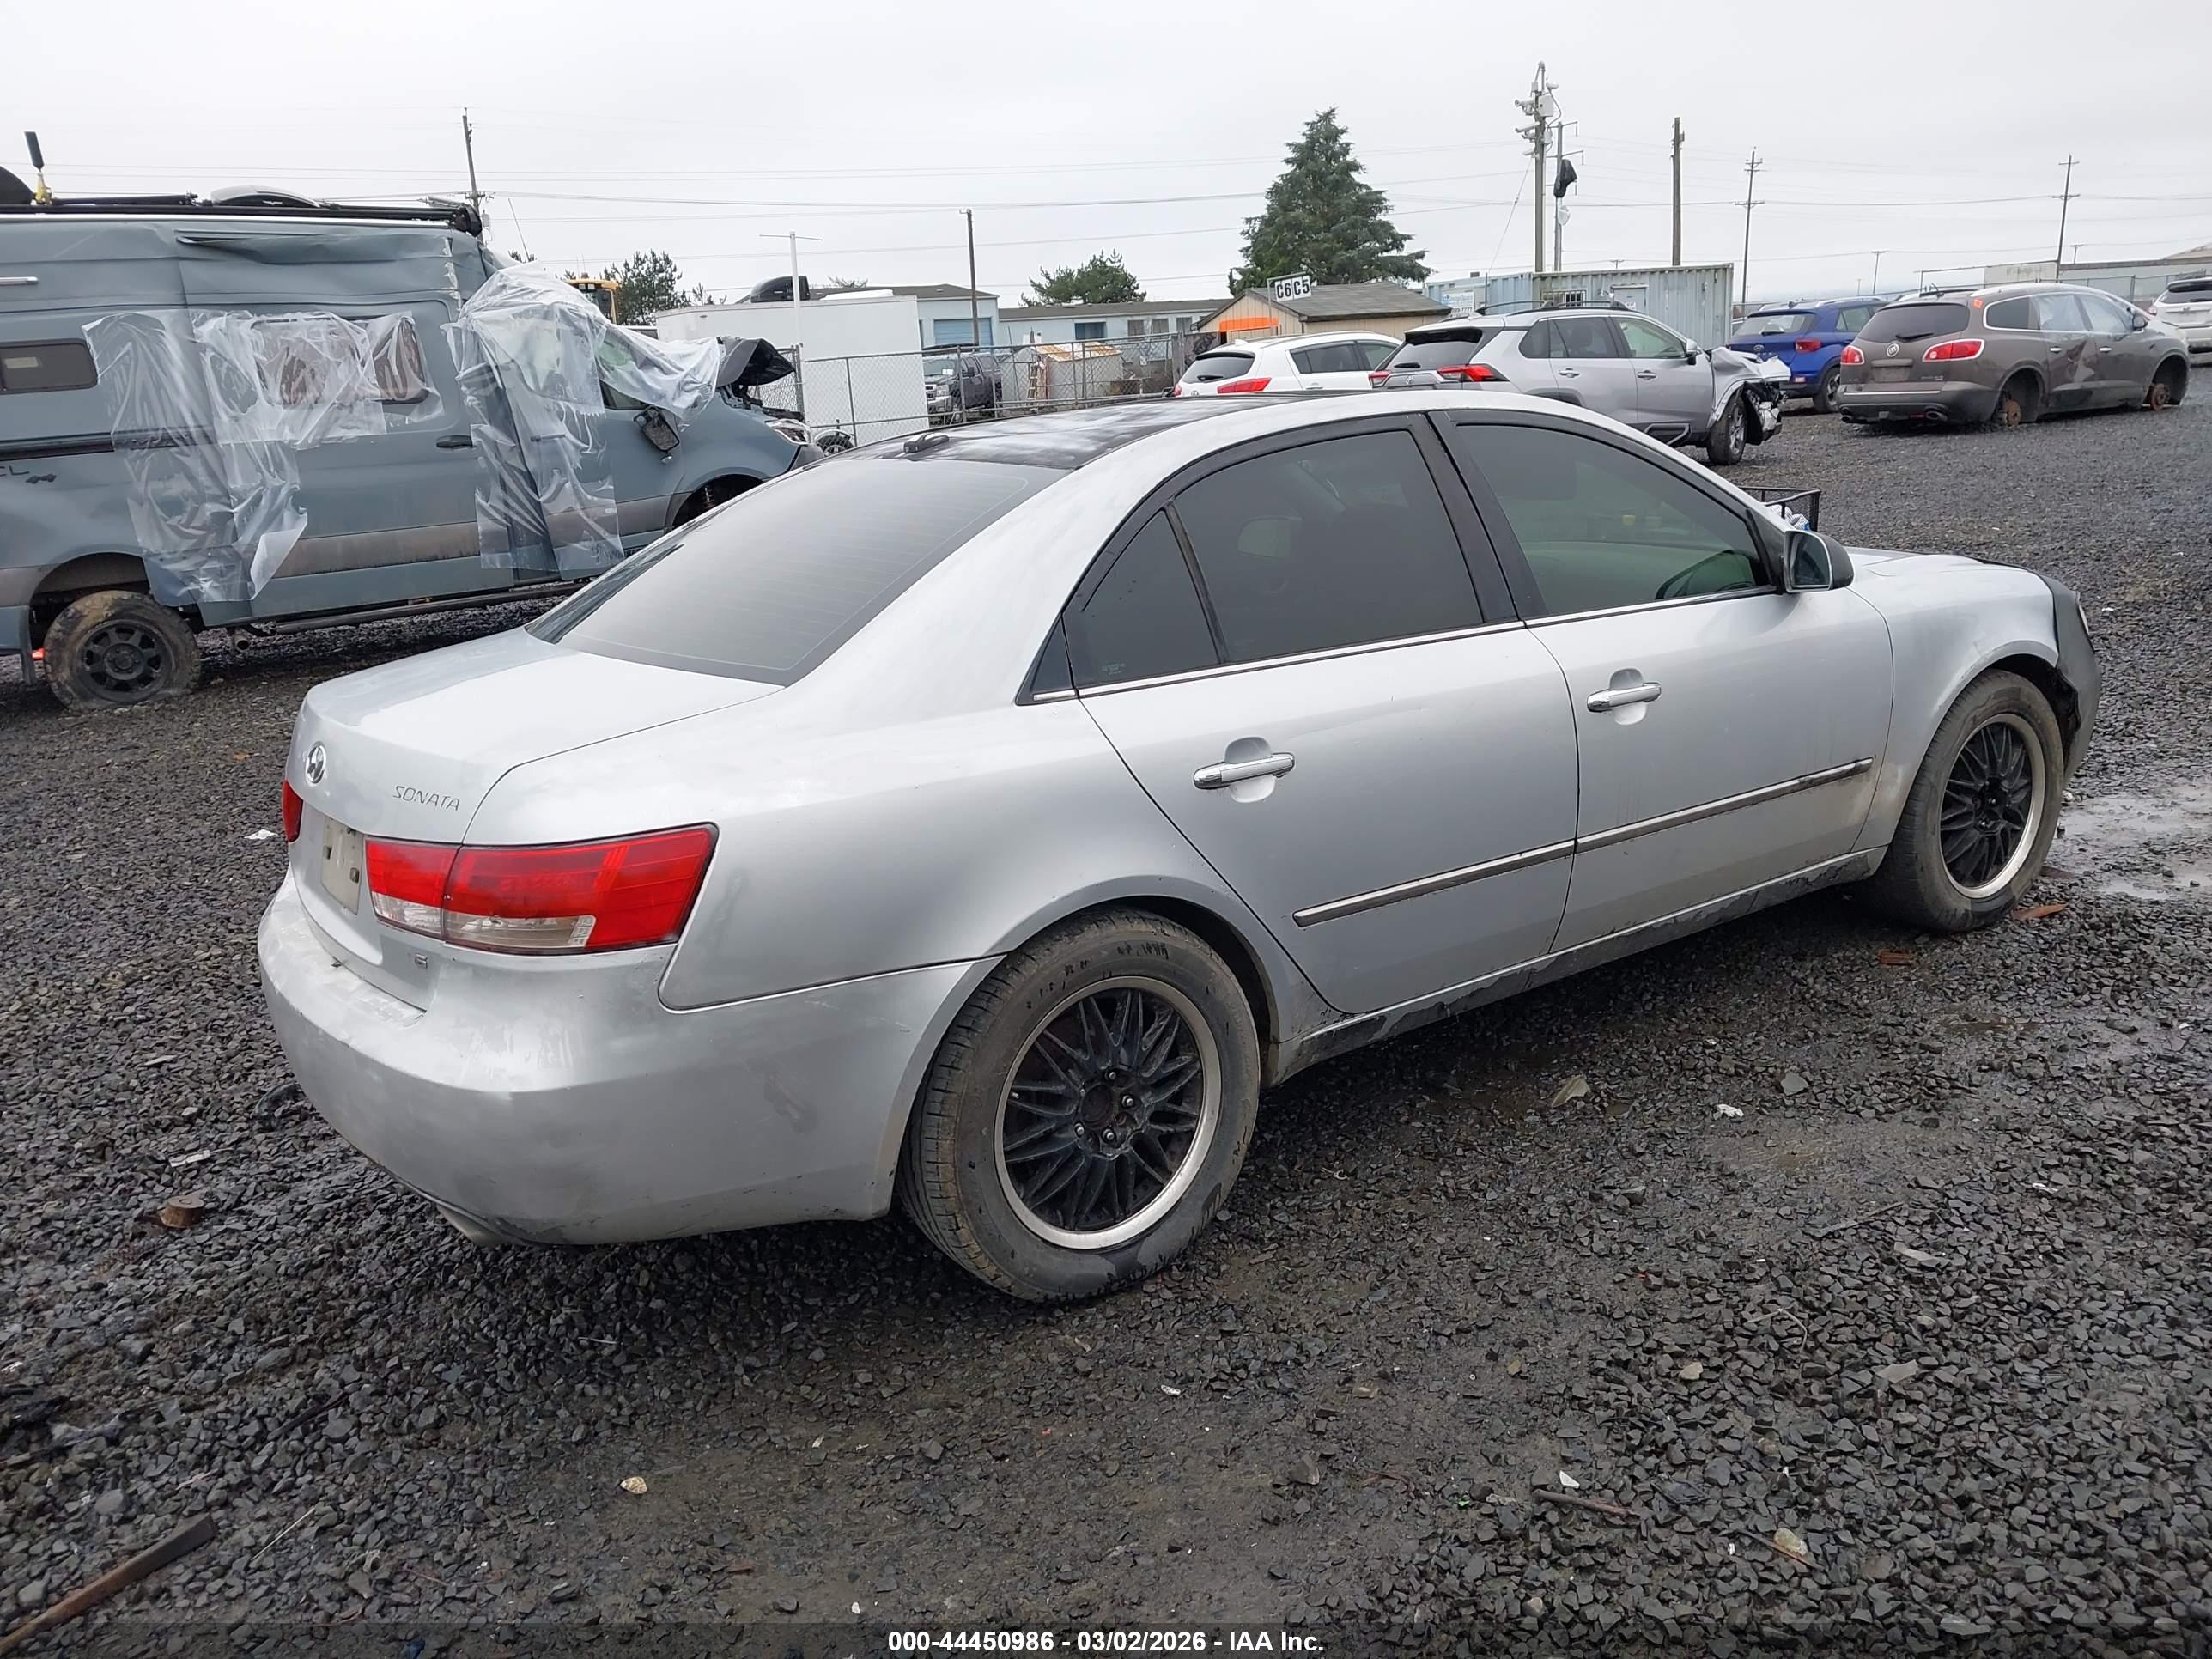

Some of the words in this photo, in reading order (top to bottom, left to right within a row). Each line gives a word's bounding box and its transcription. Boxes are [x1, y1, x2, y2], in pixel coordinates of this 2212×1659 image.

[1276, 282, 1292, 299] C6
[1293, 278, 1310, 295] C5
[392, 785, 460, 811] SONATA
